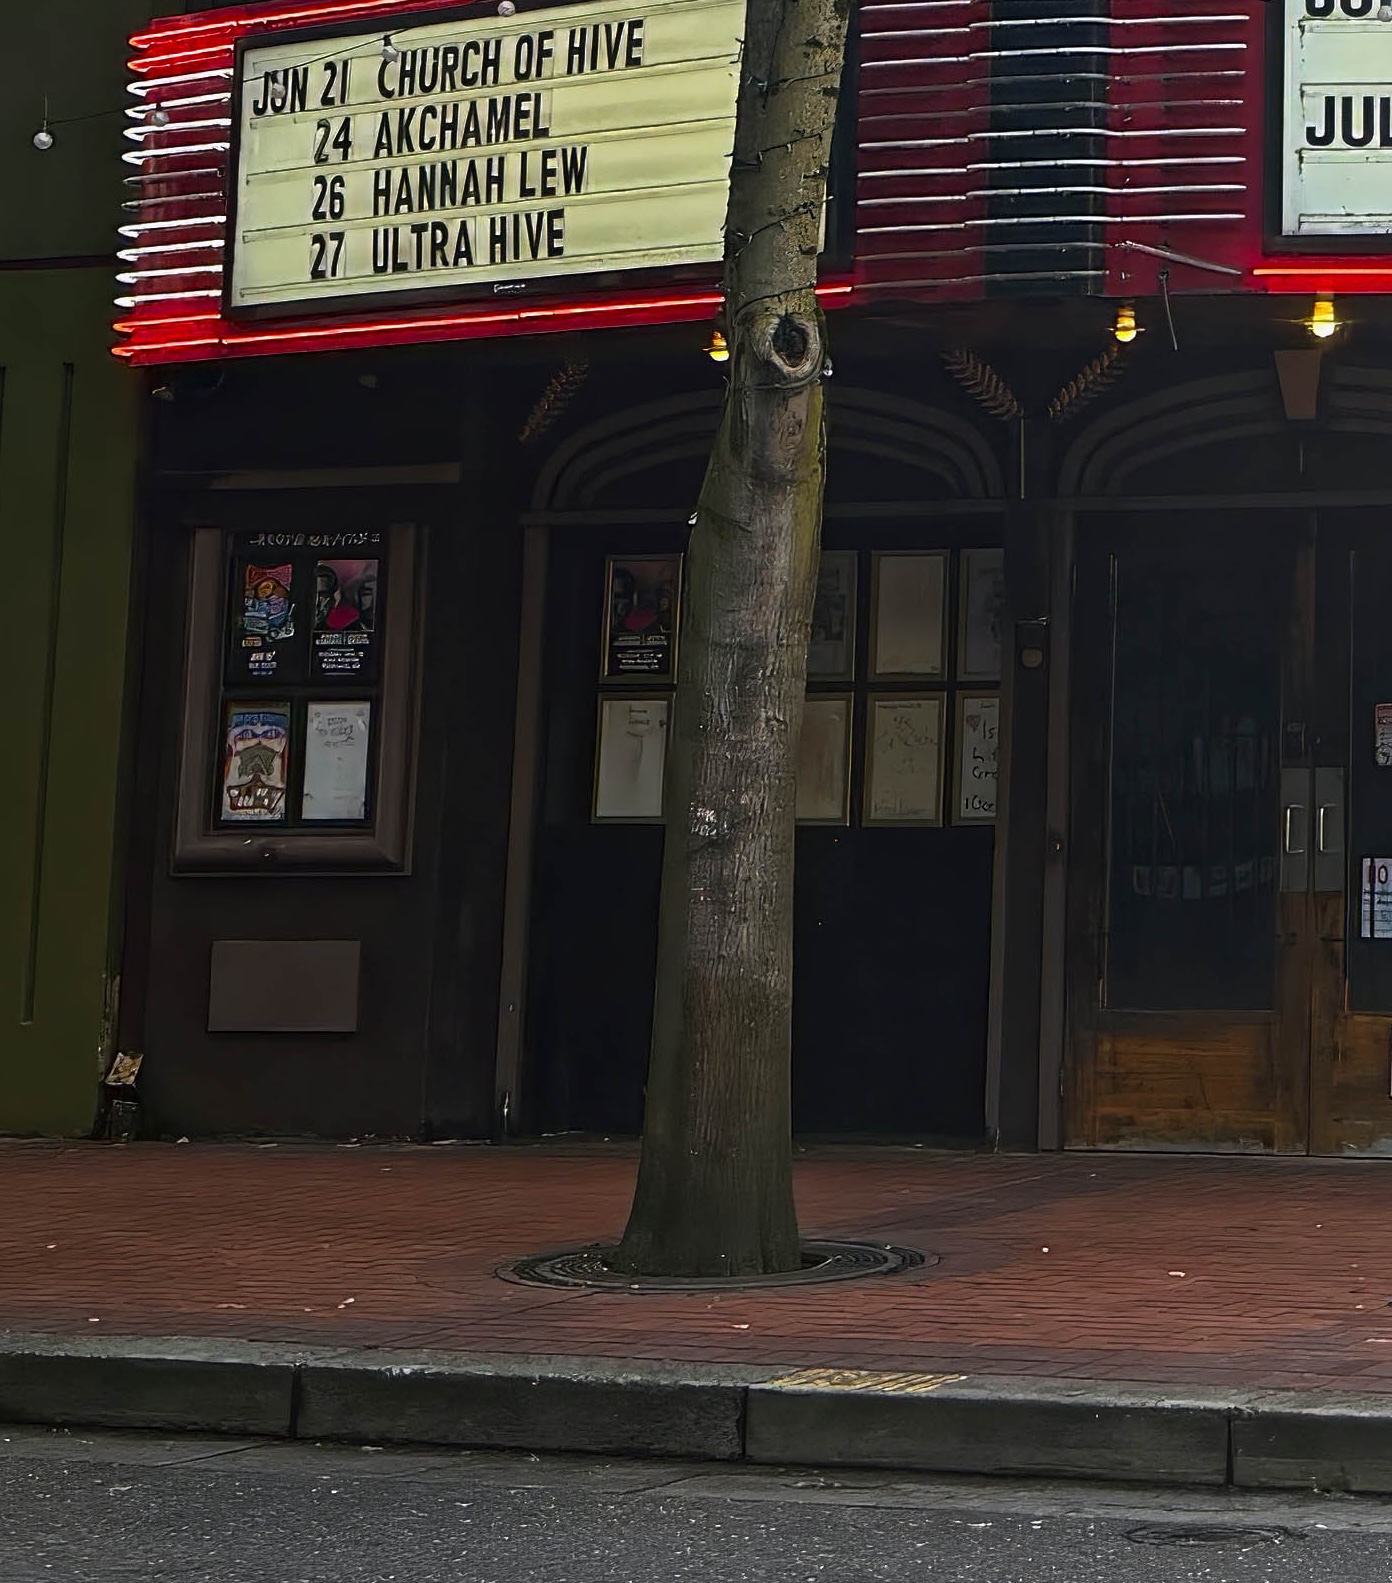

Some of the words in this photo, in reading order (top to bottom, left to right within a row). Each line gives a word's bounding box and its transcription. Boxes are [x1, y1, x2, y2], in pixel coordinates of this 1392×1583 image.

[252, 66, 309, 116] JUN
[320, 59, 351, 107] 21
[376, 40, 501, 100] CHURCH
[514, 29, 554, 82] OF
[567, 18, 644, 76] HIVE
[313, 116, 353, 164] 24
[374, 91, 551, 159] AKCHAMEL
[312, 175, 345, 221] 26
[373, 156, 504, 217] HANNAH
[519, 146, 588, 198] LEW
[310, 231, 345, 280] 27
[372, 219, 475, 274] ULTRA
[490, 208, 565, 265] HIVE
